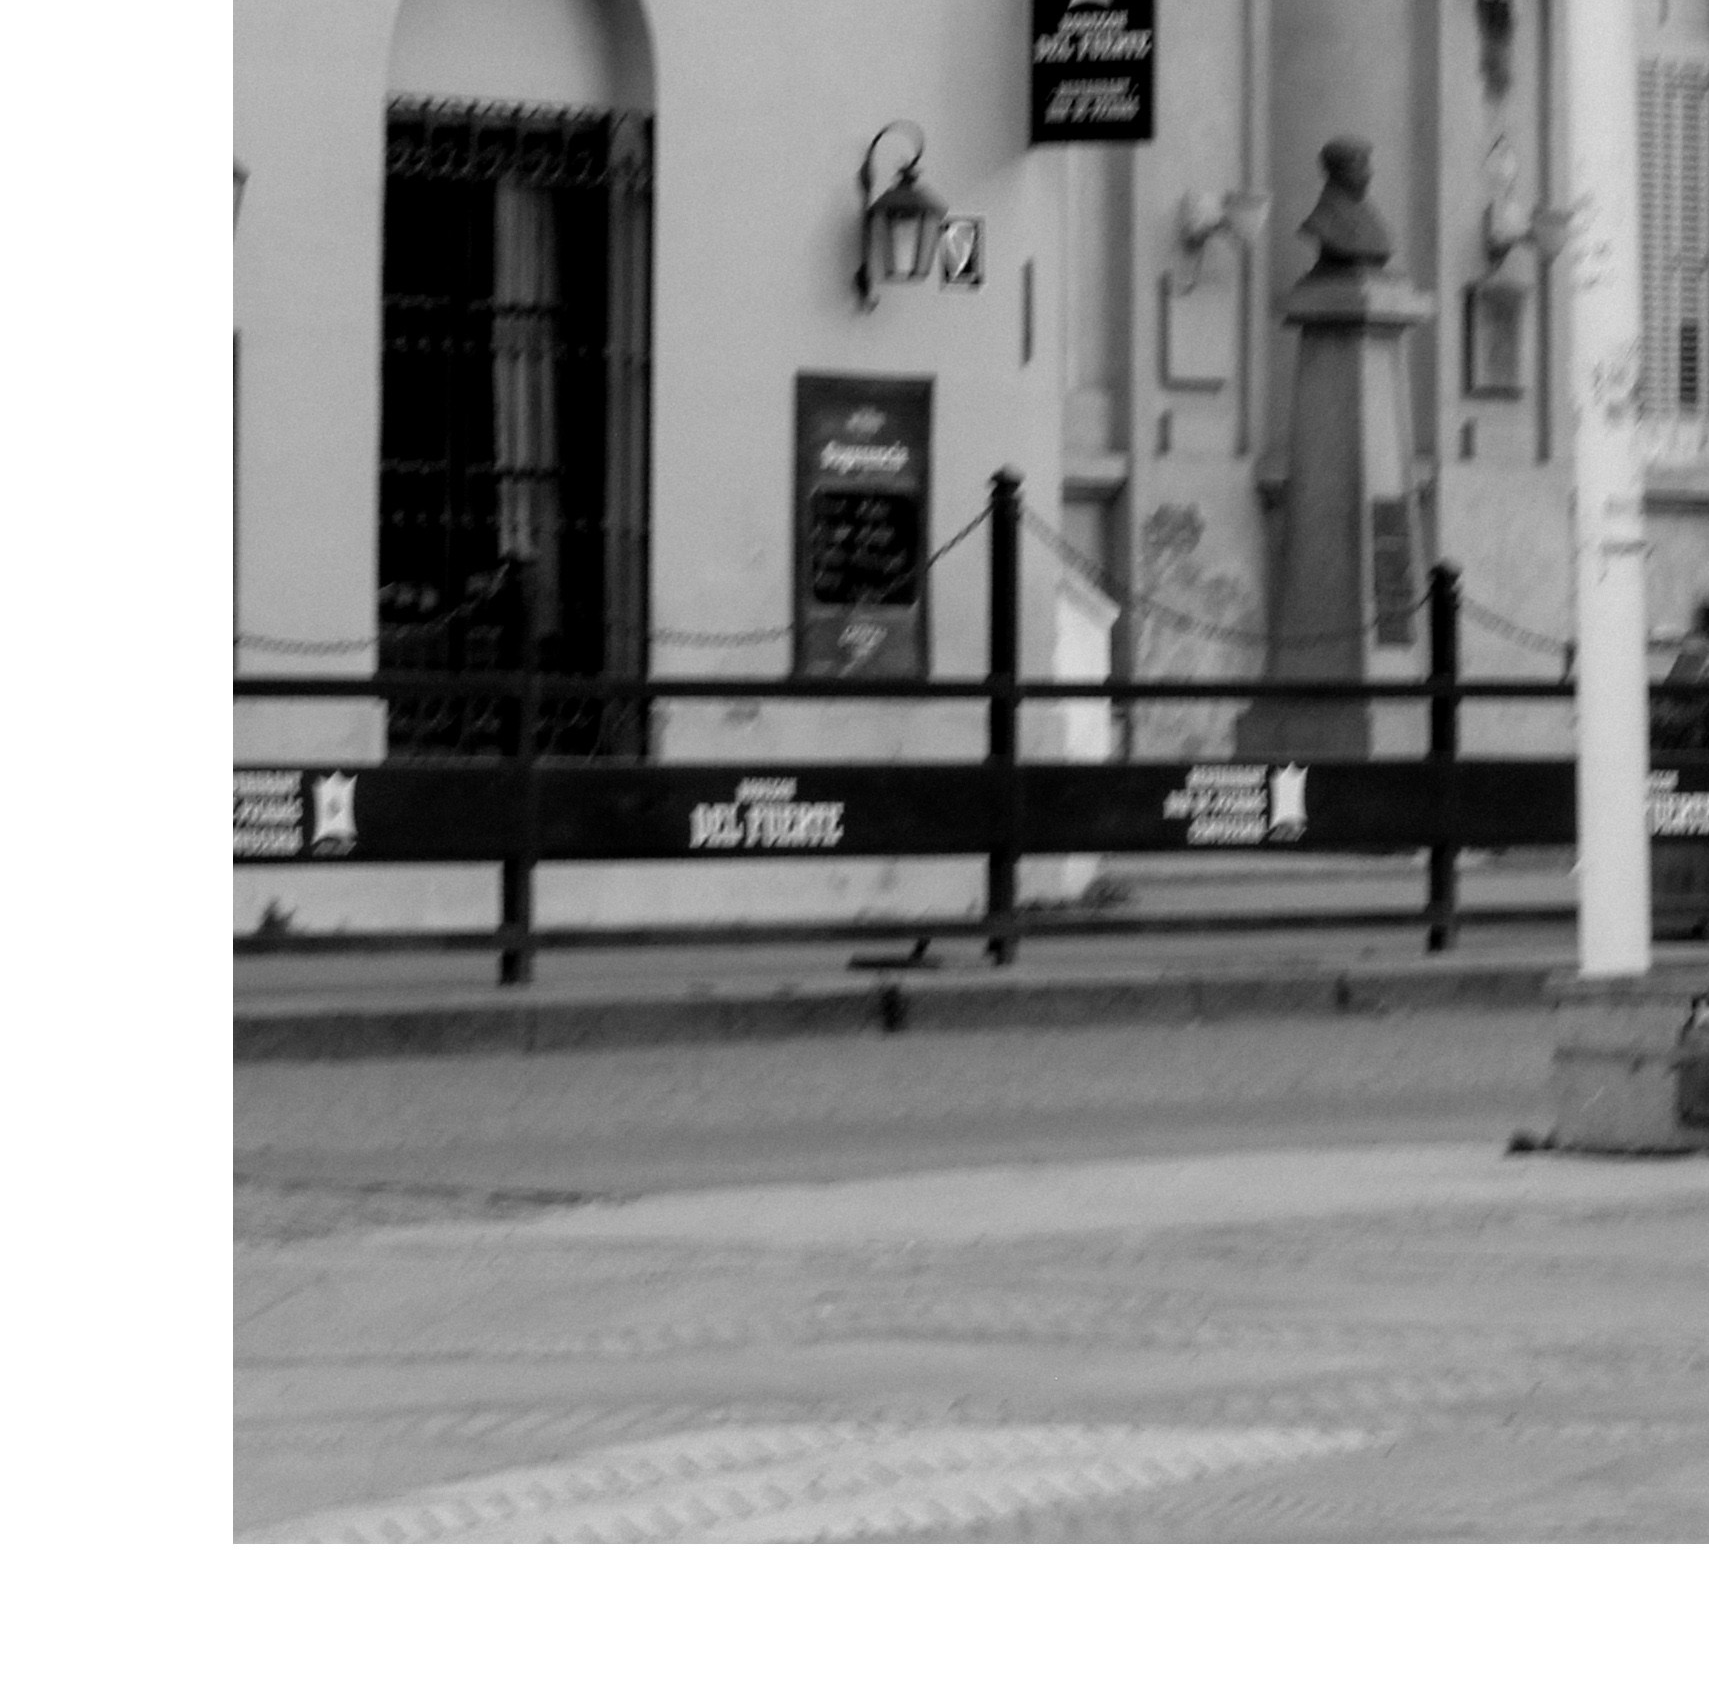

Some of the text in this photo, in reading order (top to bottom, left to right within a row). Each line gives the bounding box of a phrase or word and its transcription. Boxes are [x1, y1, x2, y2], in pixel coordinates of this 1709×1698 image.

[1076, 30, 1152, 62] FUERTE
[688, 802, 845, 849] DEL FUERTE
